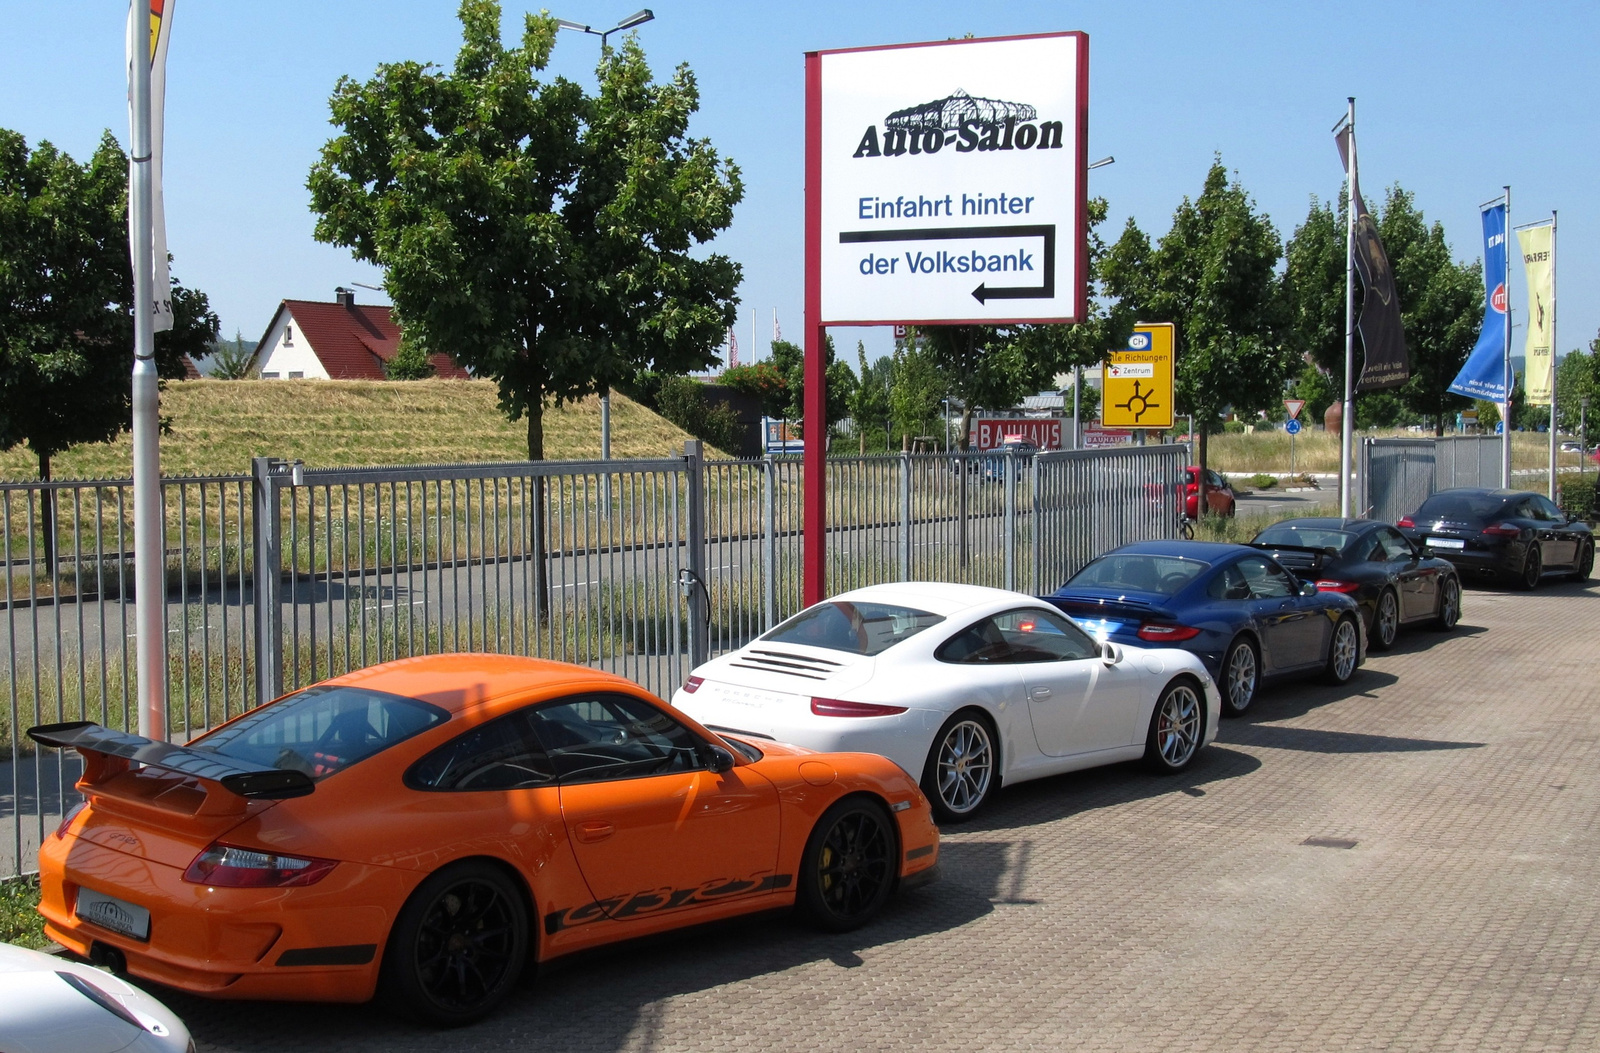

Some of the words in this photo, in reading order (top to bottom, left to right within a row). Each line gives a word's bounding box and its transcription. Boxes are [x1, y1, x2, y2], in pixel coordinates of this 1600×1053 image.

[852, 117, 1063, 158] Auto-Salon
[858, 195, 952, 219] Einfahrt
[962, 193, 1034, 215] hinter
[859, 253, 899, 275] der
[905, 249, 1034, 274] Volksbank
[1132, 338, 1144, 346] CH
[1110, 354, 1122, 362] lle
[1125, 353, 1168, 363] Richtungen
[1123, 367, 1151, 375] Zentrum
